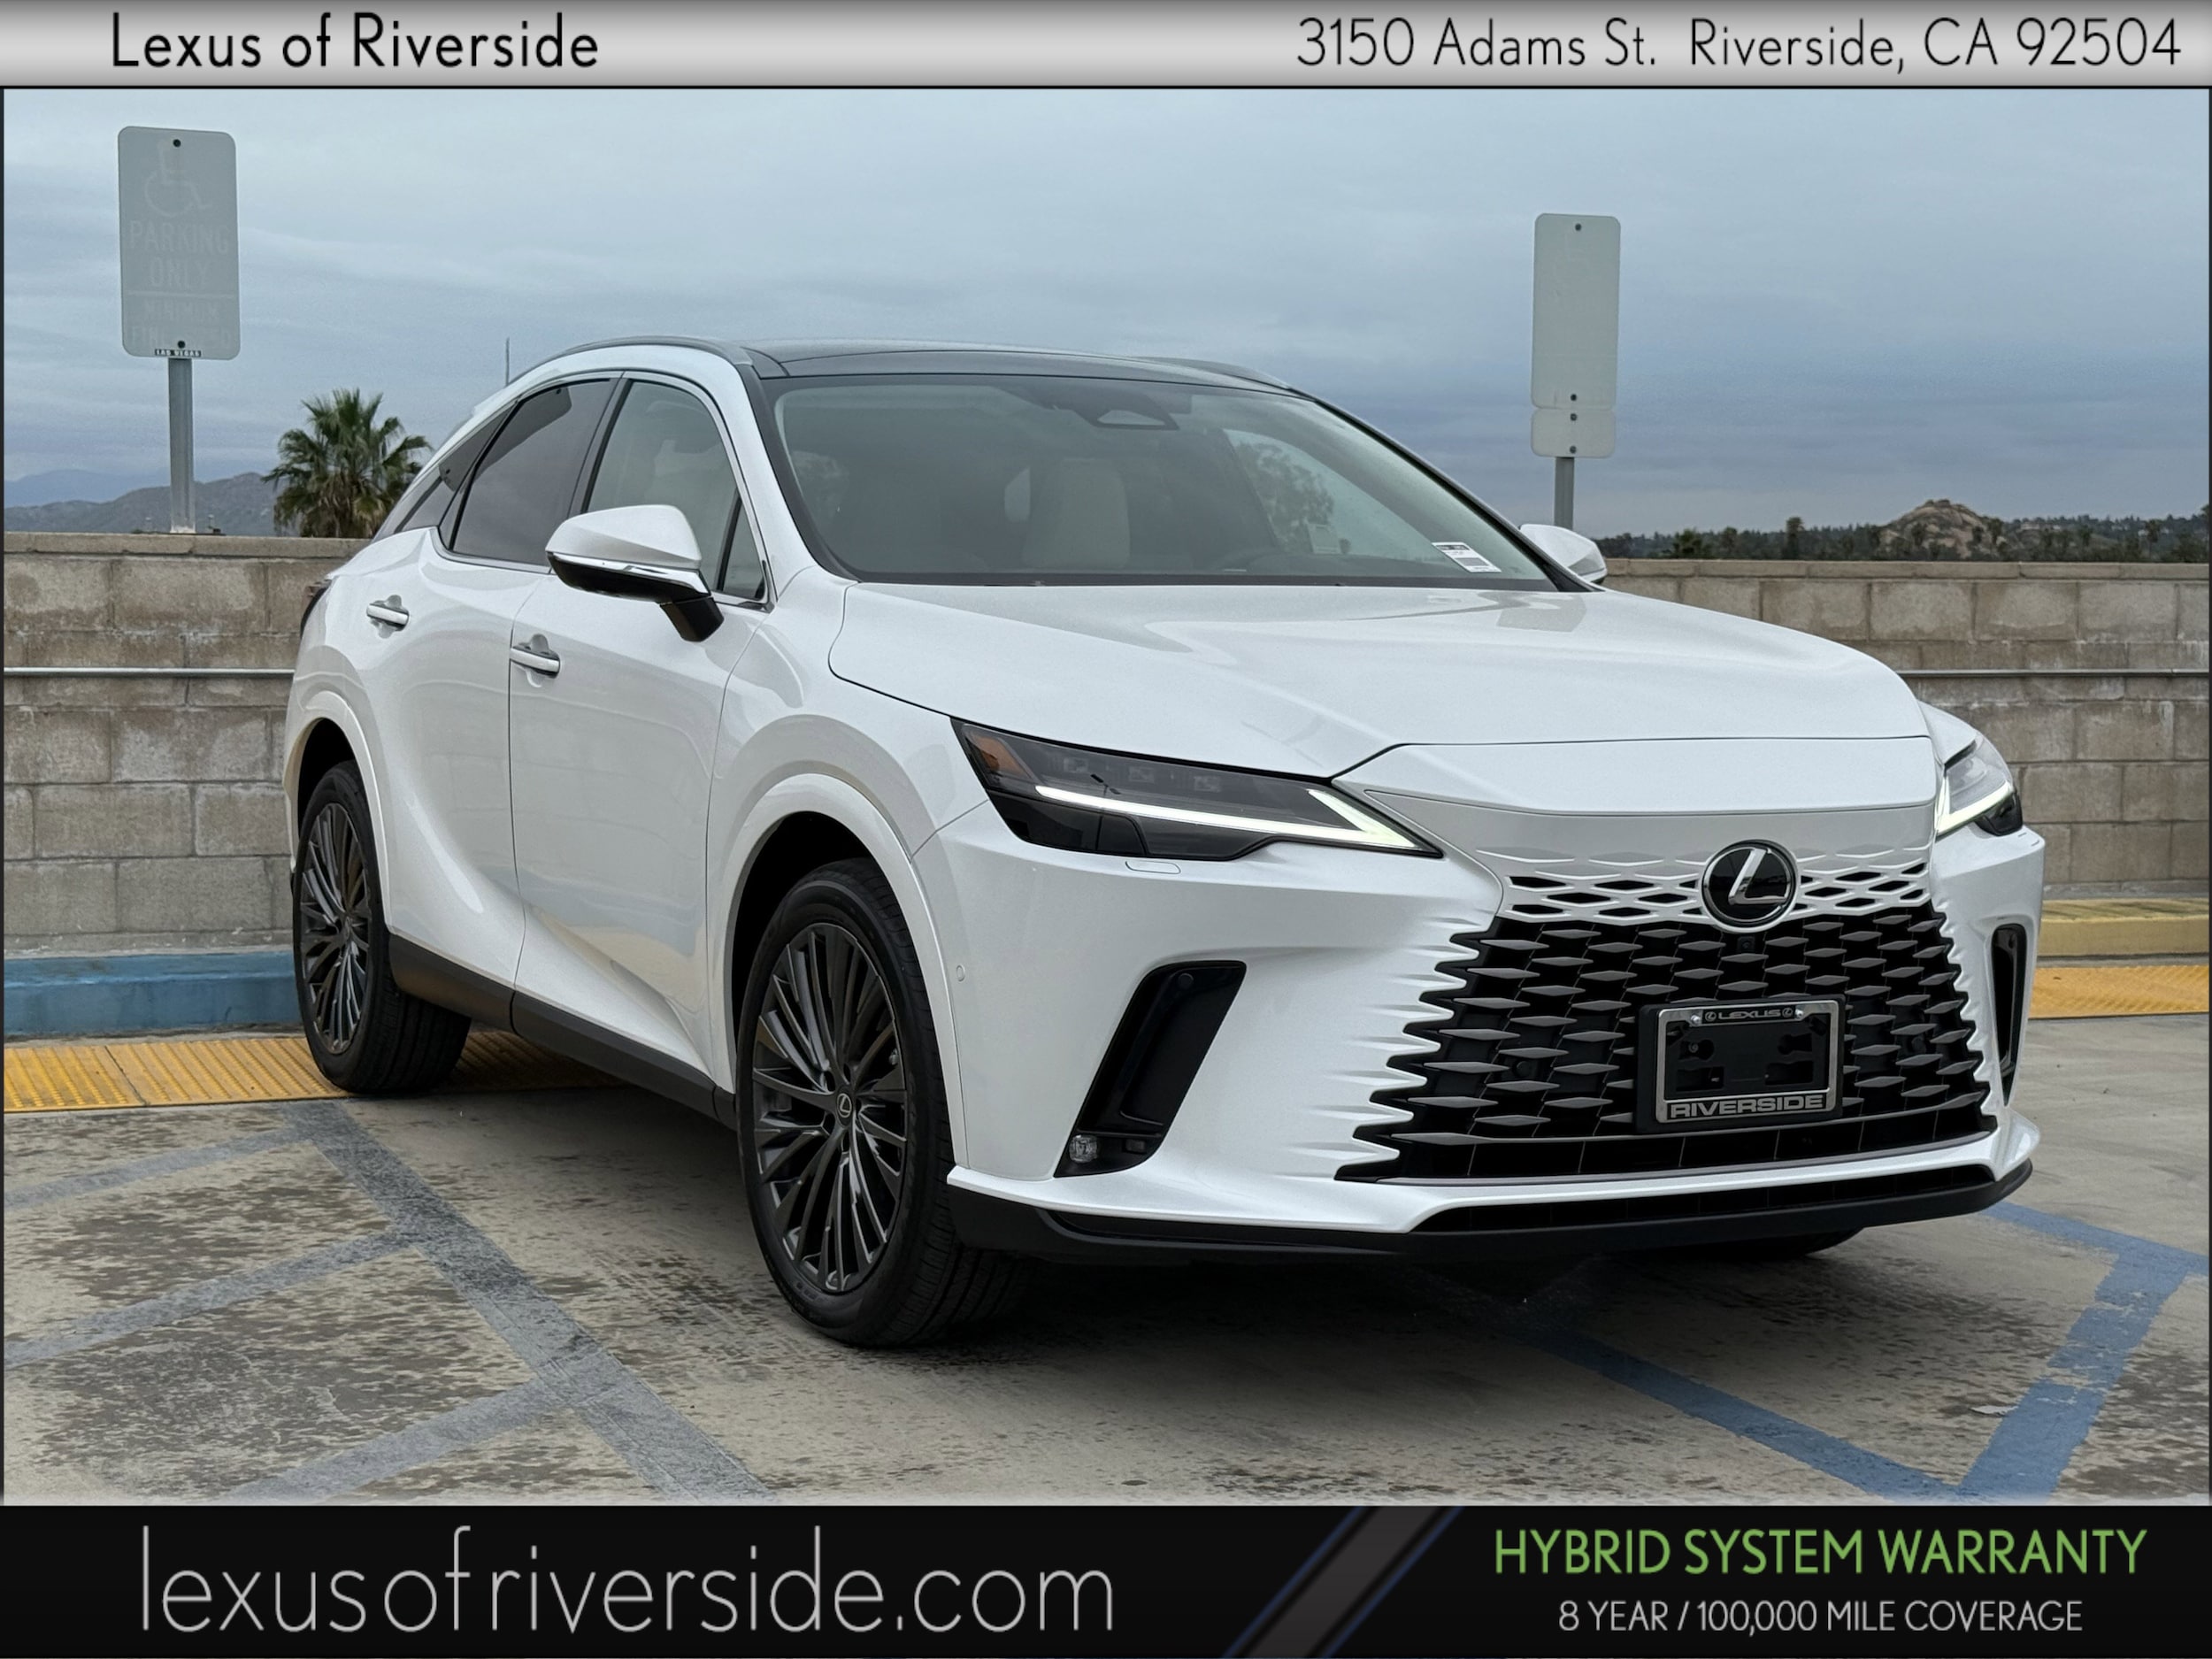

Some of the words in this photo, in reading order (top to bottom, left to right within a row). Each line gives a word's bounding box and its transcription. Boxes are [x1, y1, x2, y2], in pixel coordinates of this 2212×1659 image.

[129, 219, 228, 257] PARKING
[149, 257, 211, 289] ONLY
[1717, 1008, 1782, 1020] LEXUS
[1670, 1094, 1824, 1119] RIVERSIDE
